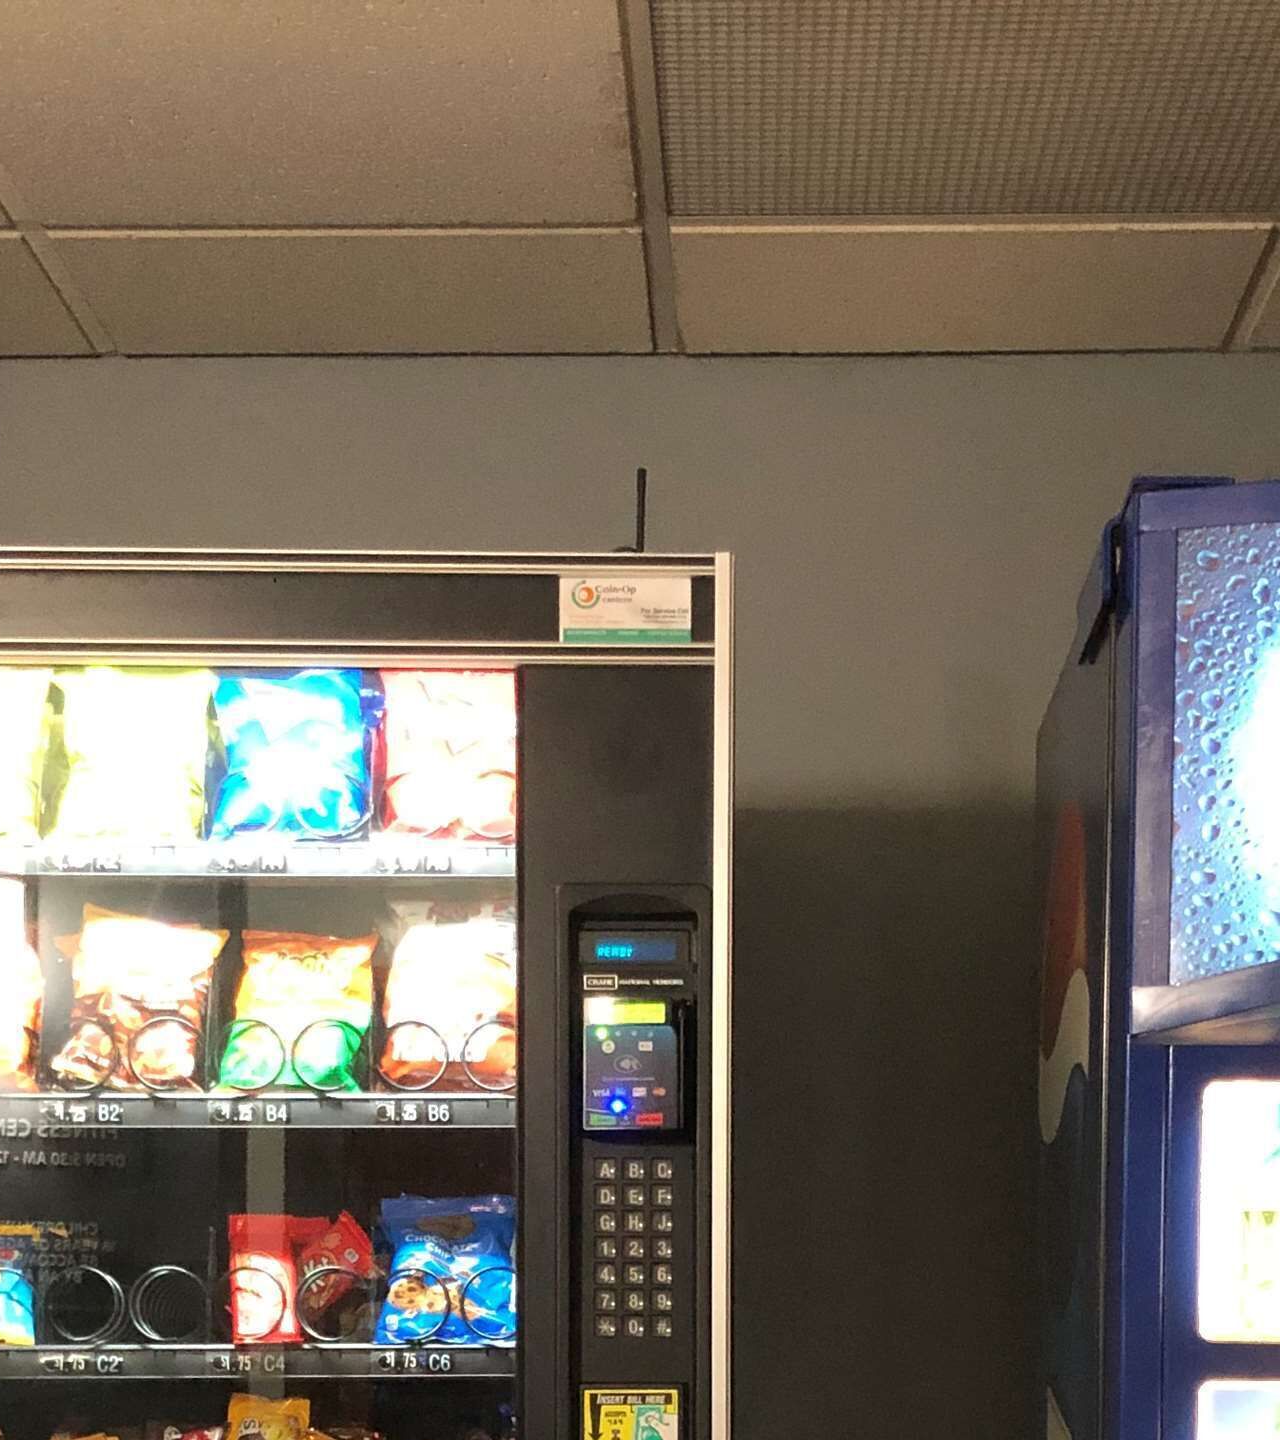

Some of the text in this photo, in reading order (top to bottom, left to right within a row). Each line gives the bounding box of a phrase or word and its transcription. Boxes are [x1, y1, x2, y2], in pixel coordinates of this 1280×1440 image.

[98, 1104, 120, 1122] B2
[265, 1104, 288, 1122] B4
[427, 1104, 450, 1122] B6
[599, 1162, 611, 1178] A
[628, 1162, 639, 1178] B
[599, 1189, 668, 1204] D E F
[599, 1215, 668, 1230] G H J
[599, 1241, 668, 1256] 1 2 3
[599, 1267, 668, 1281] 4 5 6
[599, 1293, 668, 1308] 7 8 9
[96, 1355, 120, 1373] C2
[264, 1354, 287, 1371] C4
[428, 1353, 451, 1371] C6
